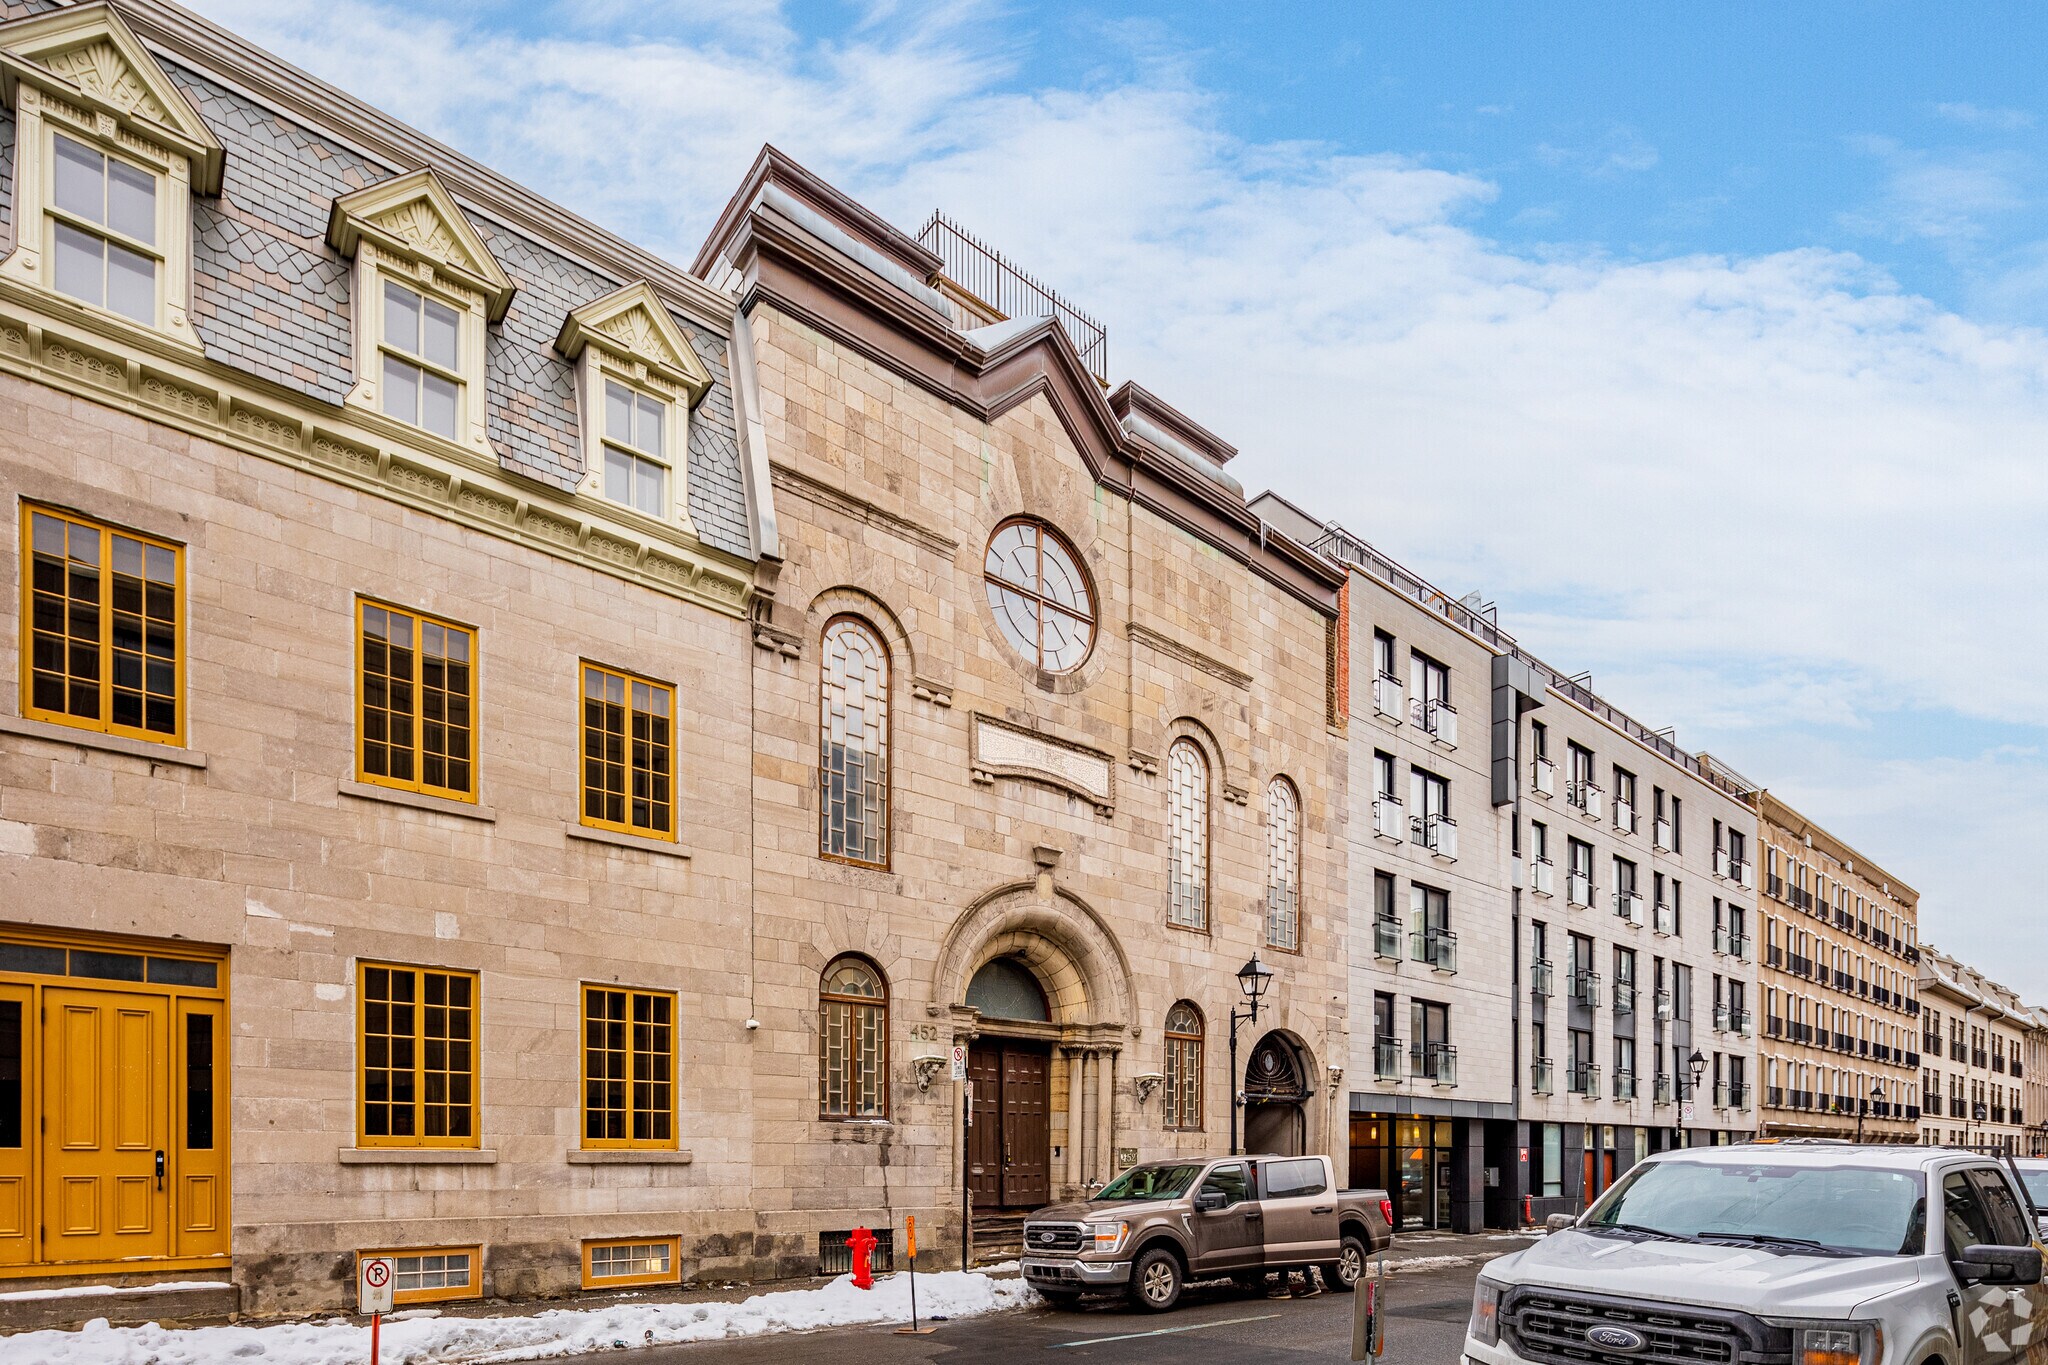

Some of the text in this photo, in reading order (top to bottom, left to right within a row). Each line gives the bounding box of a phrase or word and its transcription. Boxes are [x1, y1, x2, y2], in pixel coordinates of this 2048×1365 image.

[911, 1024, 937, 1040] 452
[374, 1267, 383, 1281] P
[1599, 1331, 1627, 1345] Ford
